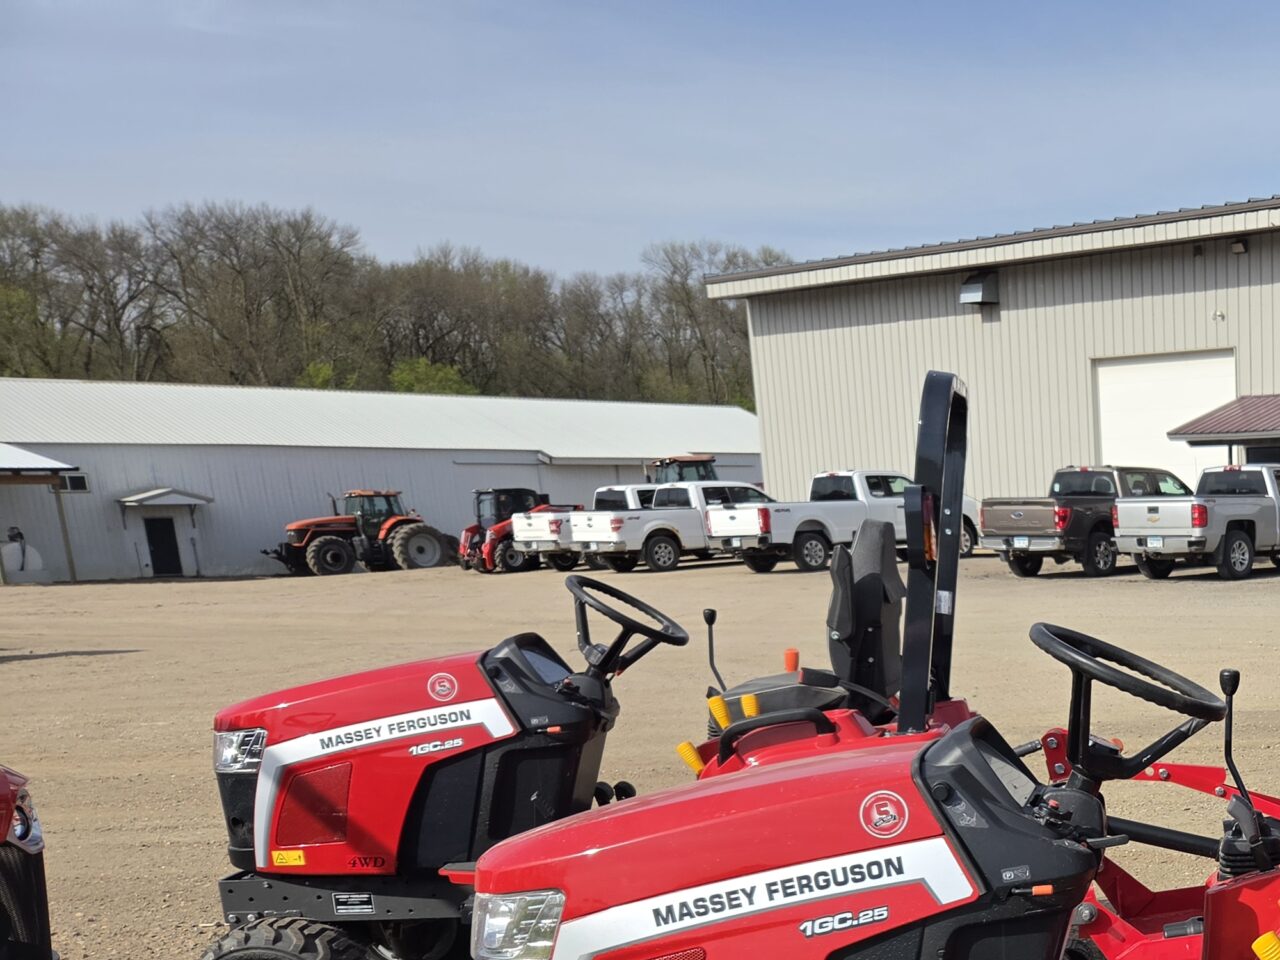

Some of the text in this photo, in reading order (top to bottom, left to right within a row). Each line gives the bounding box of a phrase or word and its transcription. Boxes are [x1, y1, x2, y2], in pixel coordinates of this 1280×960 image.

[319, 709, 472, 750] MASSEY FERGUSON
[408, 738, 464, 756] 1GC.25
[347, 856, 385, 868] 4WD
[652, 856, 905, 927] MASSEY FERGUSON
[799, 906, 889, 937] 1GC.25
